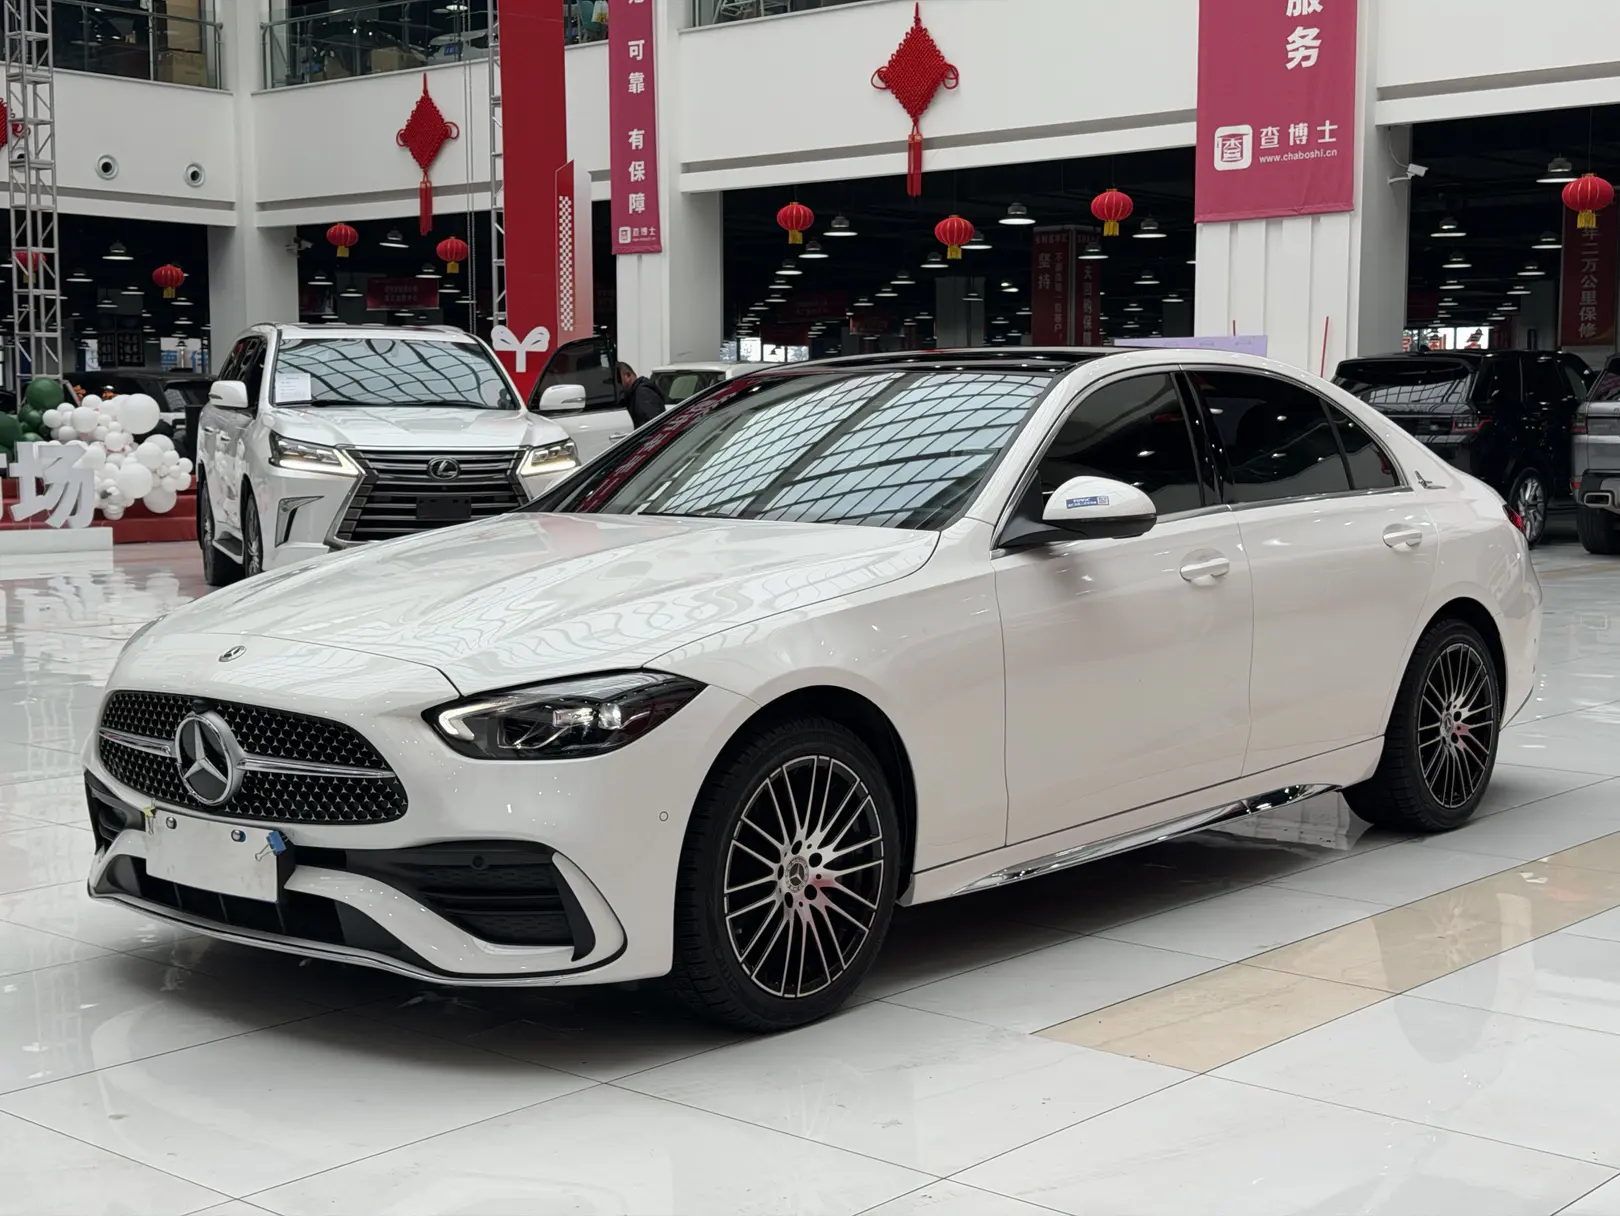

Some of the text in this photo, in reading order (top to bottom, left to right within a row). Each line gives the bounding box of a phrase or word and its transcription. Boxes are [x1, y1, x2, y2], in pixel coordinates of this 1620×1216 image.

[627, 39, 646, 94] 可靠
[1259, 149, 1338, 164] www.chaboshi.cn
[1260, 120, 1338, 149] 查博士
[628, 128, 646, 215] 有保障
[0, 440, 95, 529] 场
